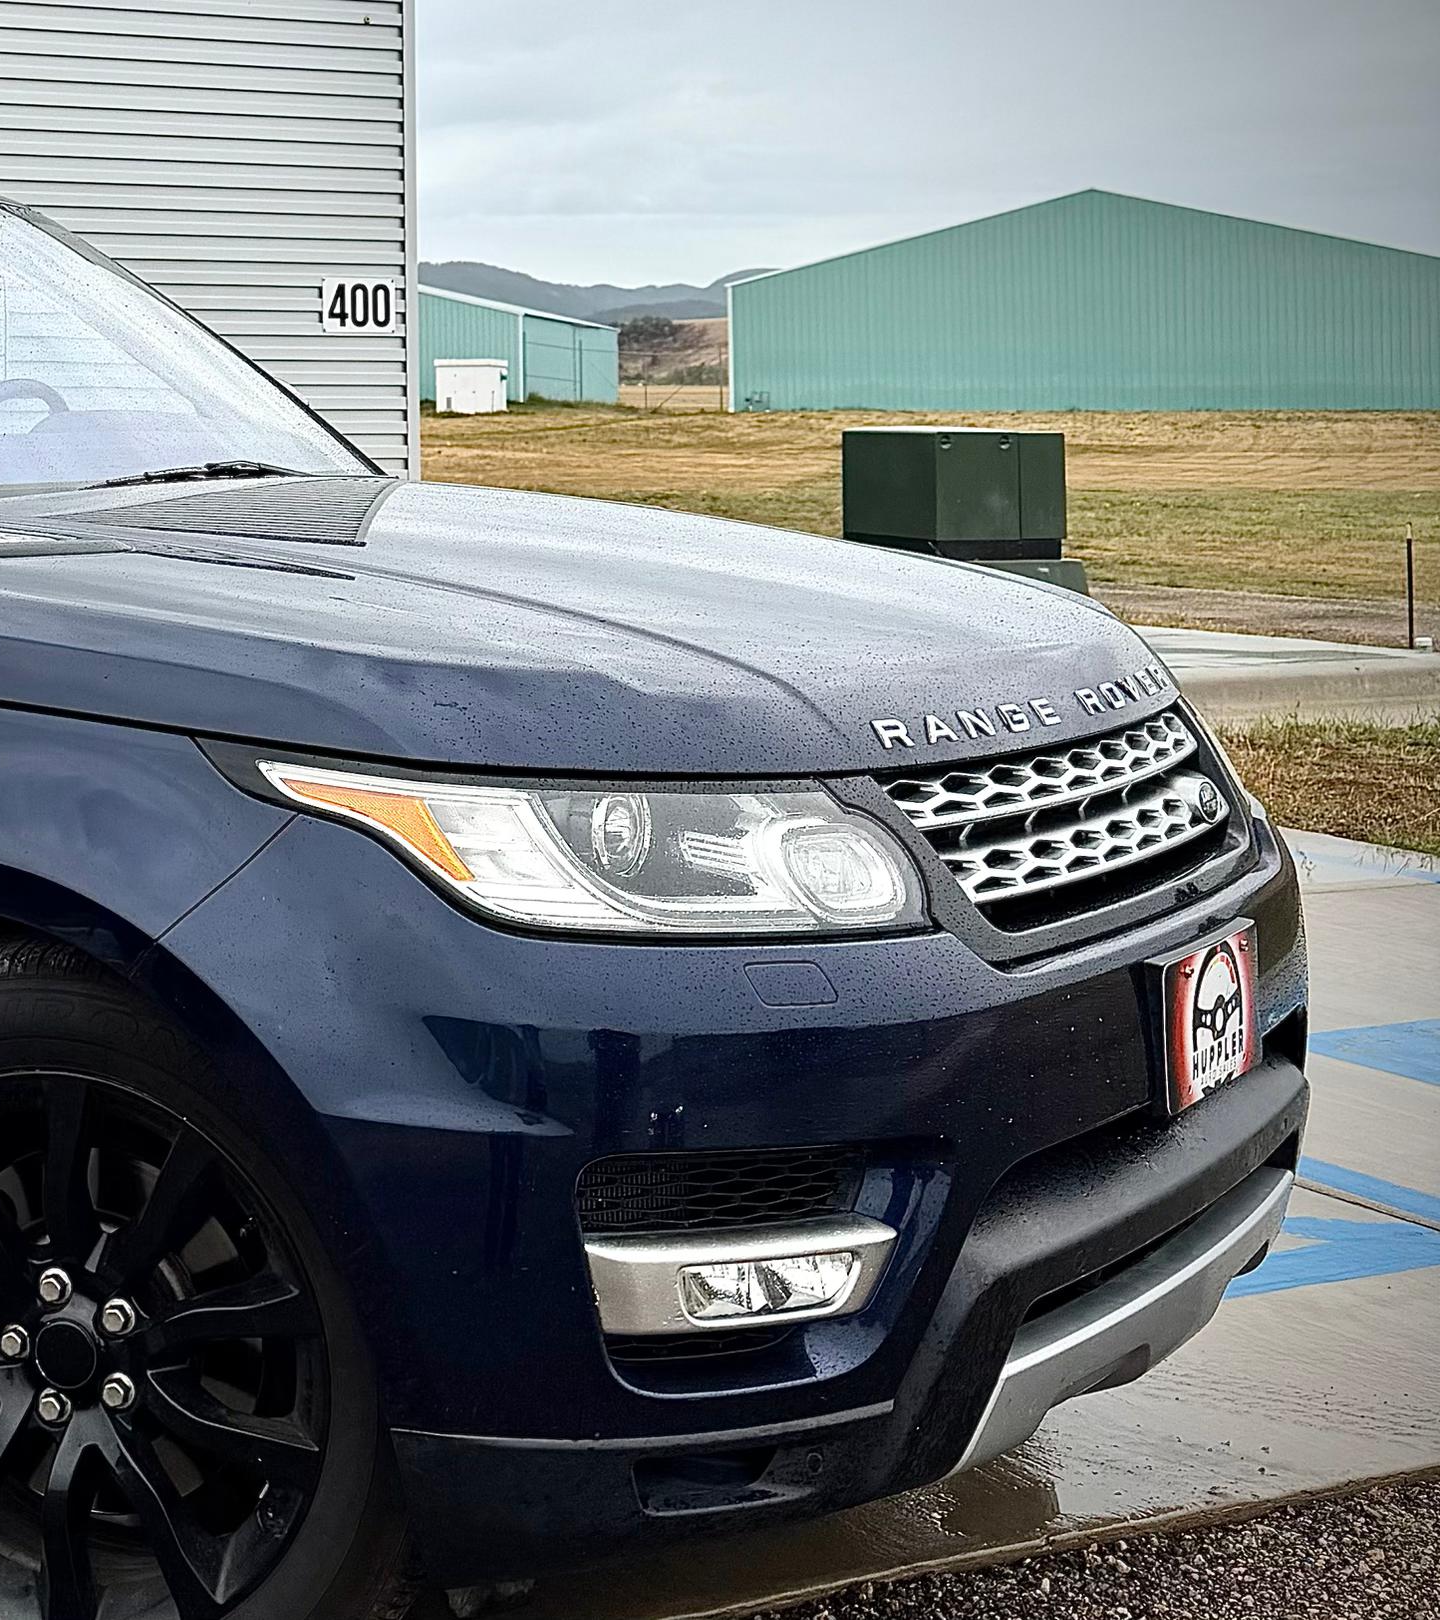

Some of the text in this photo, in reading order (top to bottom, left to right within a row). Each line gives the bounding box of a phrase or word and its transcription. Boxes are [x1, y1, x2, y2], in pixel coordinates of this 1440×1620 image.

[328, 283, 390, 327] 400
[869, 664, 1171, 749] RANGE ROVER
[1192, 1027, 1244, 1081] HUPPLER
